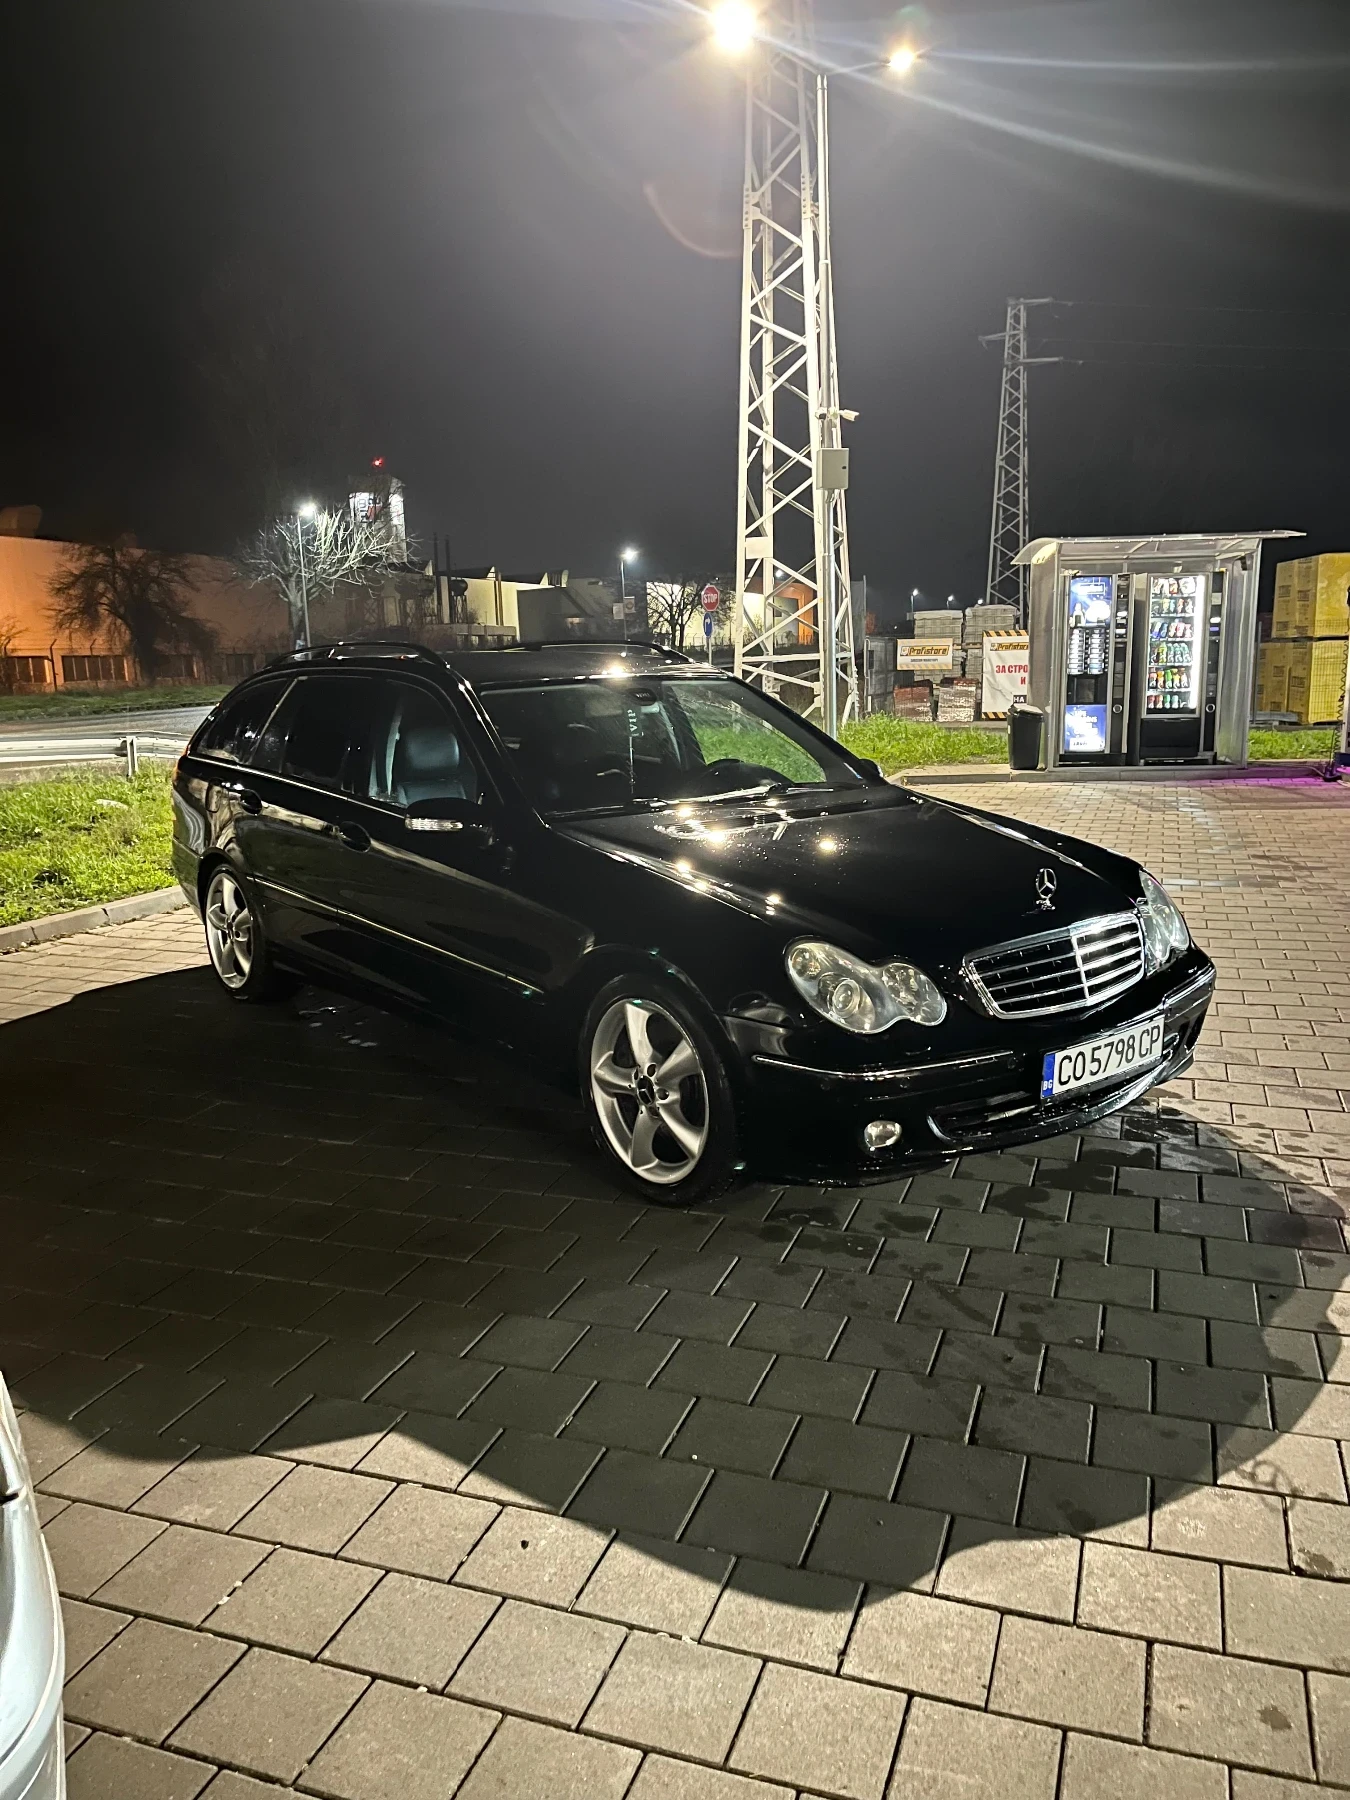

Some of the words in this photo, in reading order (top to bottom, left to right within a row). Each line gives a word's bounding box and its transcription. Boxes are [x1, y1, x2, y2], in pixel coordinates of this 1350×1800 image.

[703, 593, 718, 604] STOP
[909, 646, 947, 655] Profistore
[995, 665, 1006, 674] ЗА
[627, 709, 638, 732] VIP
[1058, 1050, 1086, 1086] CO
[1089, 1034, 1136, 1077] 5798
[1138, 1024, 1161, 1059] CP
[1043, 1080, 1053, 1091] BG
